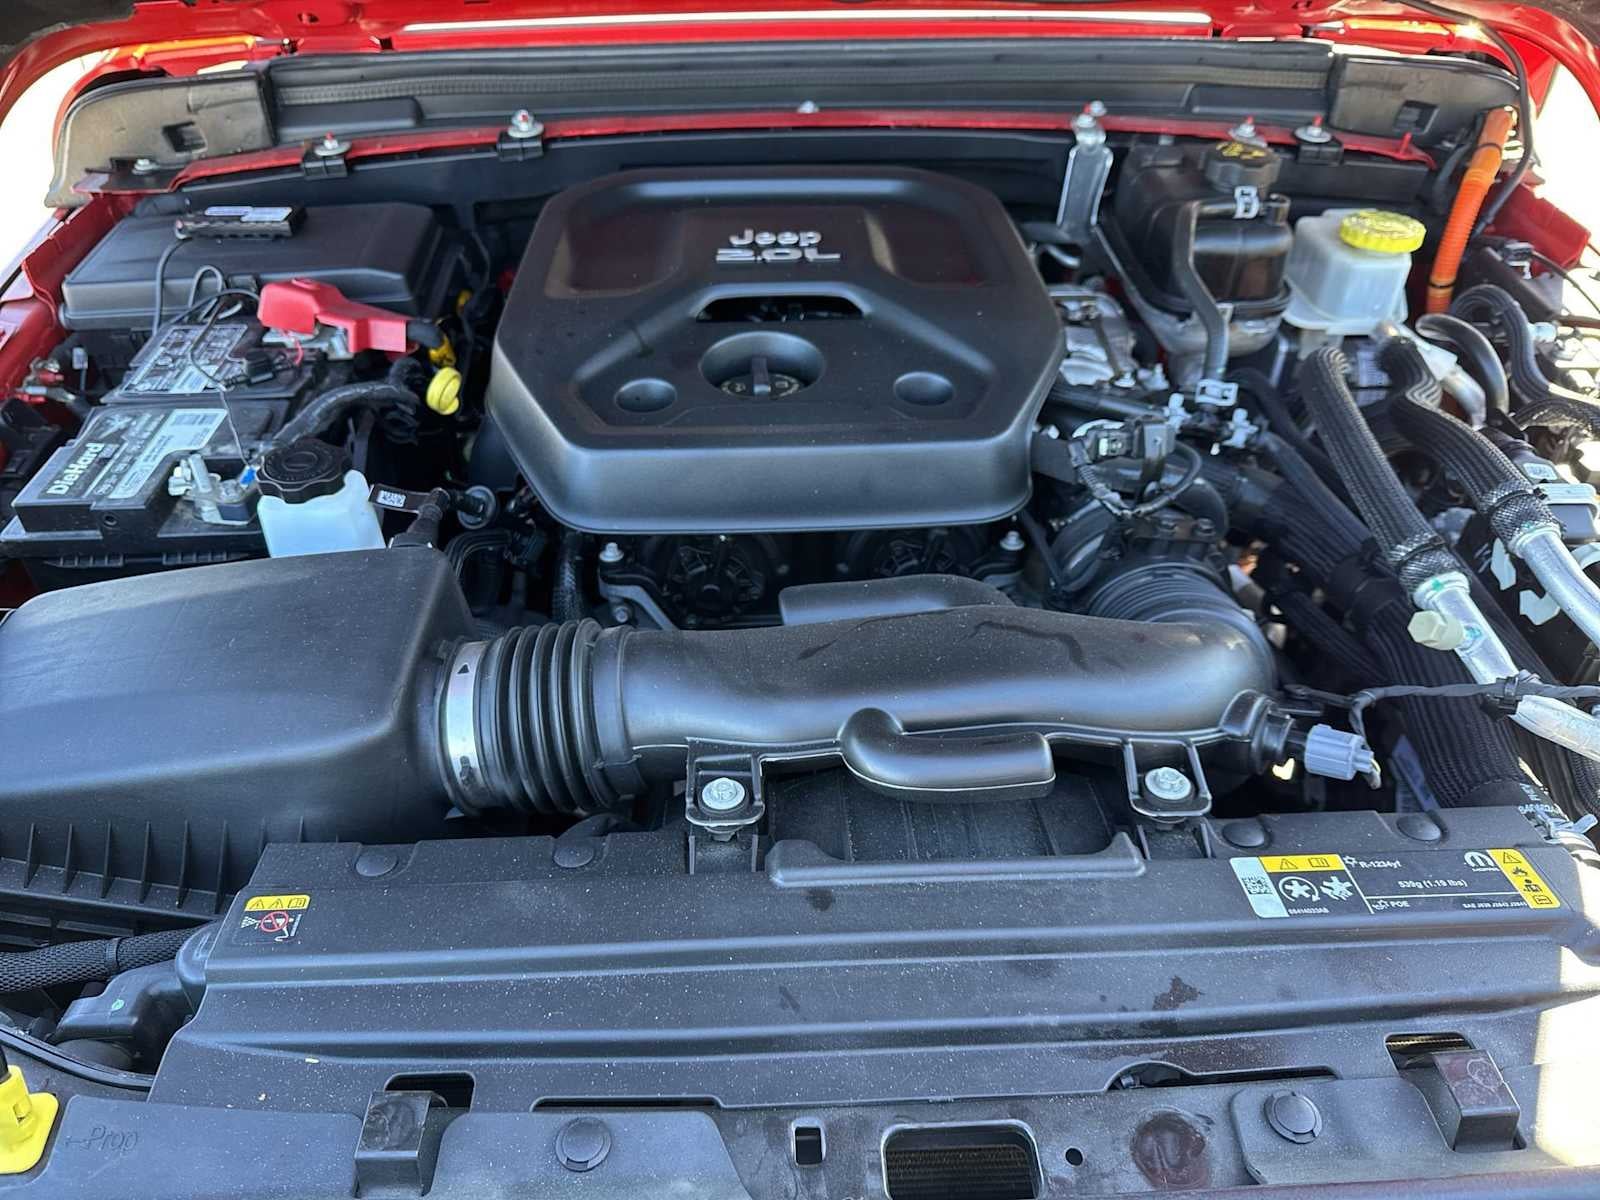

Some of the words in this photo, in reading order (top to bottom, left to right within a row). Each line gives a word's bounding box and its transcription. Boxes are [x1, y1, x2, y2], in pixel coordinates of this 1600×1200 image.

[728, 228, 822, 247] Jeep
[715, 247, 842, 264] 2.0L
[46, 442, 106, 495] DieHard
